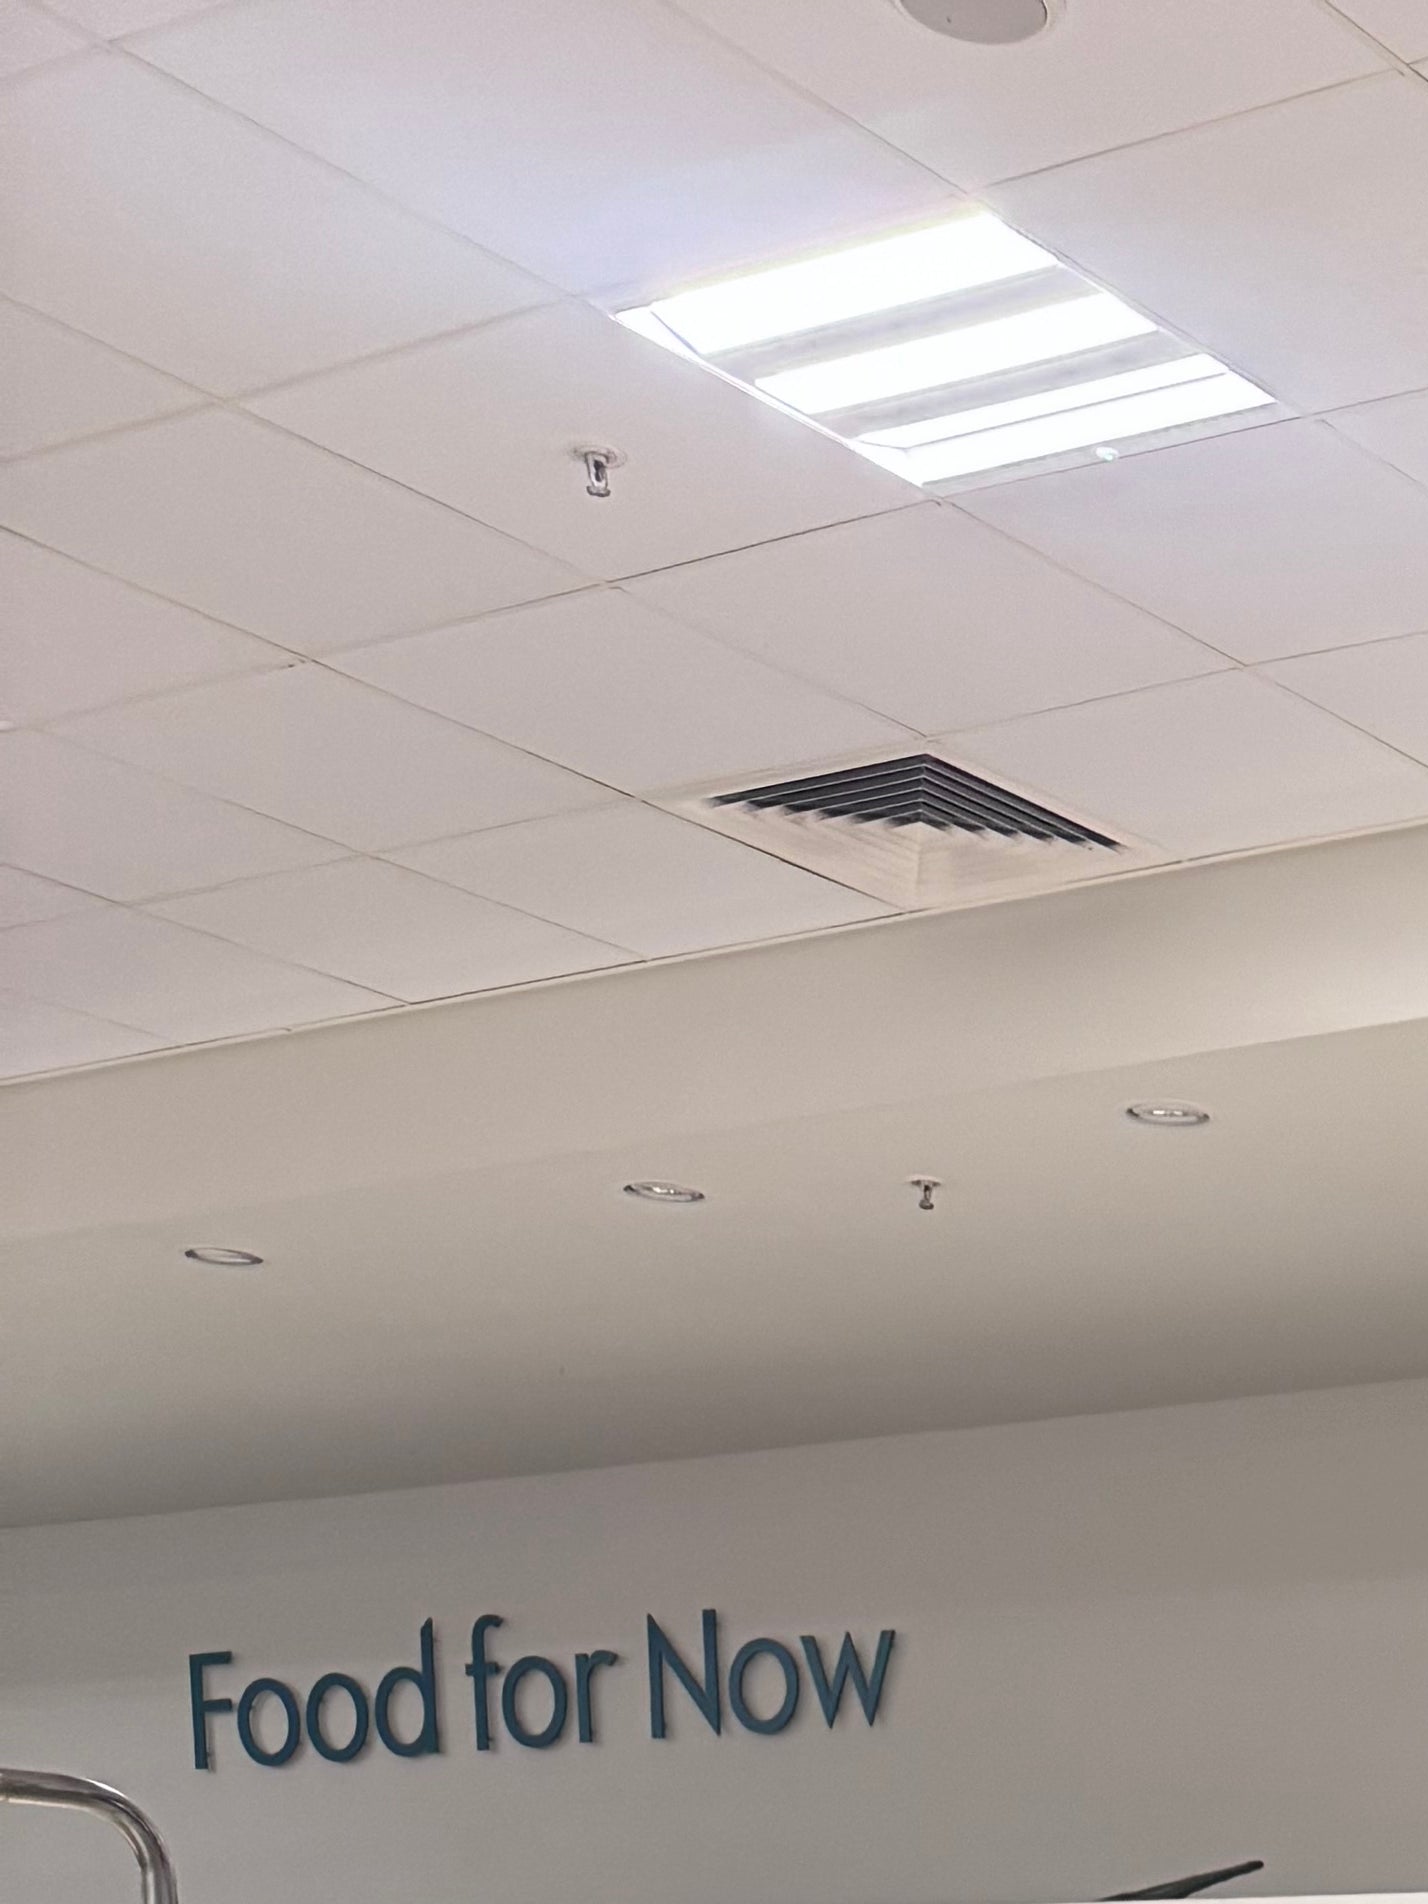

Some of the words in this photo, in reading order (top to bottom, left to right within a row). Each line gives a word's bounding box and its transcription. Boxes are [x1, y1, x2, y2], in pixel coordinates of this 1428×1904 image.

[189, 1617, 441, 1770] Food
[466, 1613, 619, 1751] for
[647, 1608, 897, 1738] Now
